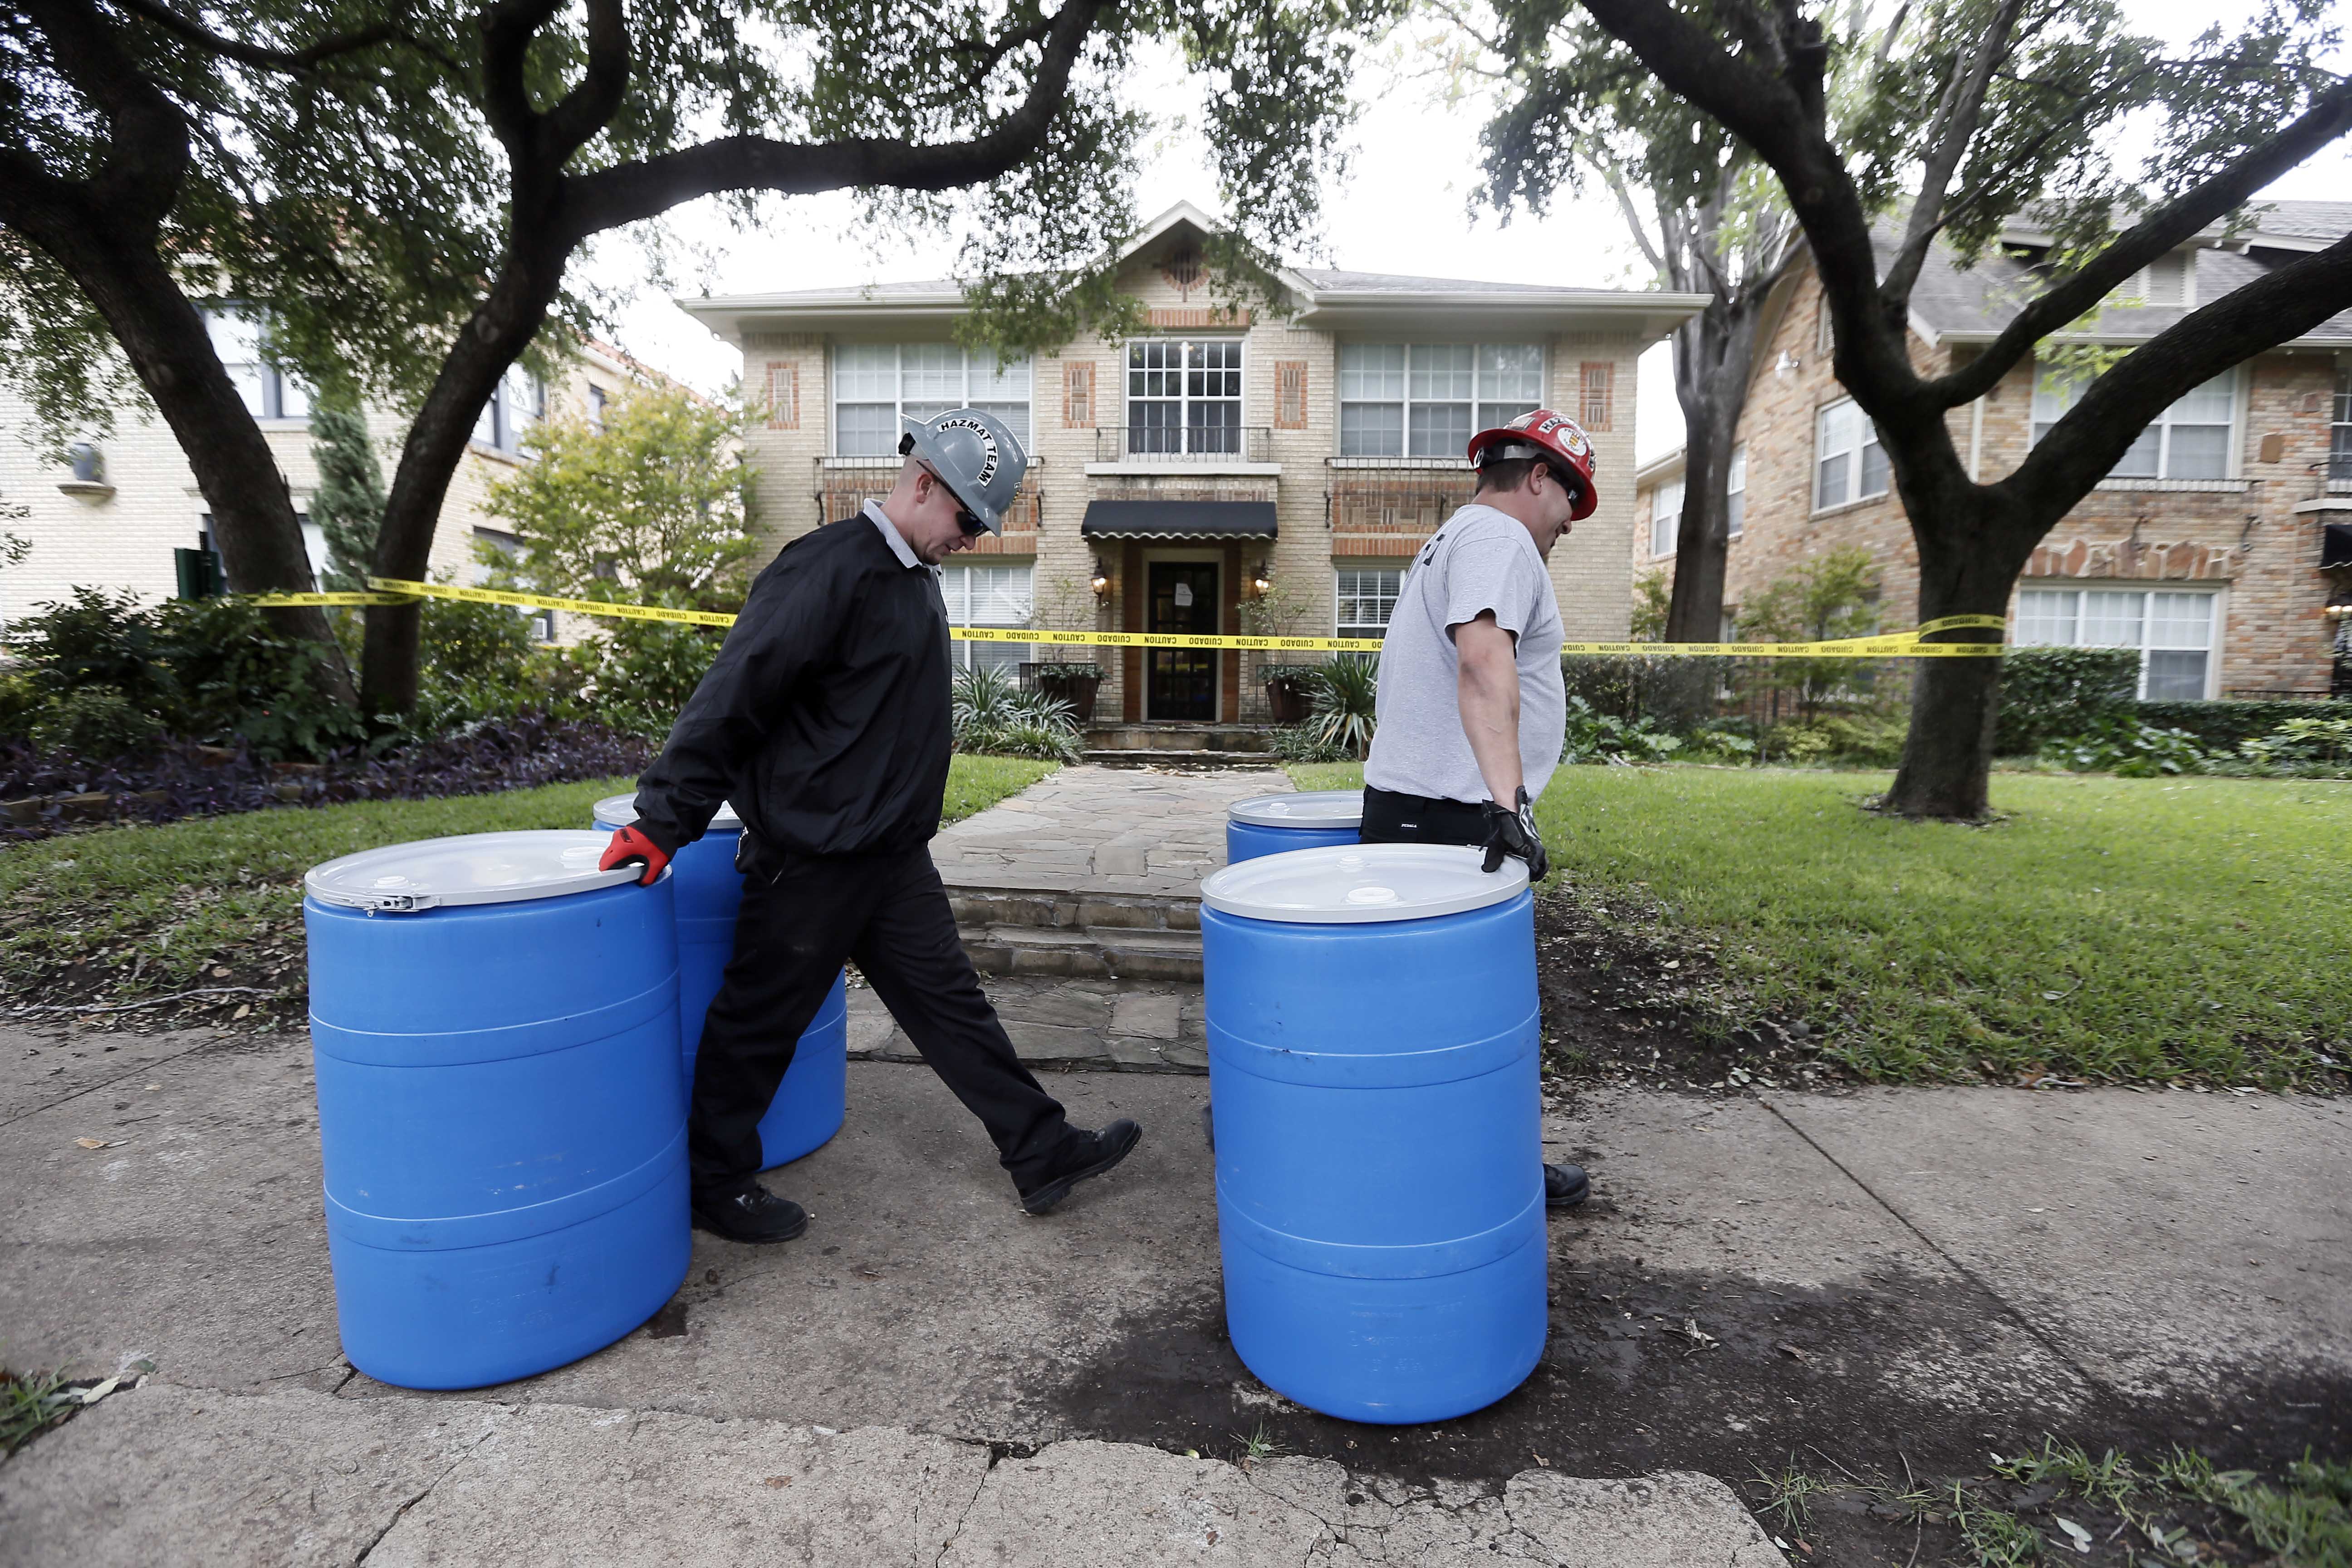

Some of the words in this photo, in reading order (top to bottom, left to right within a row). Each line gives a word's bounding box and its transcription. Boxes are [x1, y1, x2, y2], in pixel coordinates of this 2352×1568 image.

[941, 420, 992, 440] HAZMAT
[978, 446, 997, 482] TEAM
[537, 598, 564, 607] CAUTION
[575, 603, 604, 612] CUIDADO
[617, 607, 645, 616] CAUTION
[656, 611, 686, 620] CUIDADO
[699, 615, 729, 623] CAUTION
[962, 630, 994, 638] CAUTION
[1006, 632, 1039, 640] CUIDADO
[1053, 633, 1085, 642] CAUTION
[1098, 634, 1131, 643] CUIDADO
[1145, 636, 1177, 644] CAUTION
[1189, 637, 1222, 646] CUIDADO
[1236, 638, 1269, 647] CAUTION
[1281, 639, 1313, 647] CUIDADO
[1328, 640, 1360, 648] CAUTION
